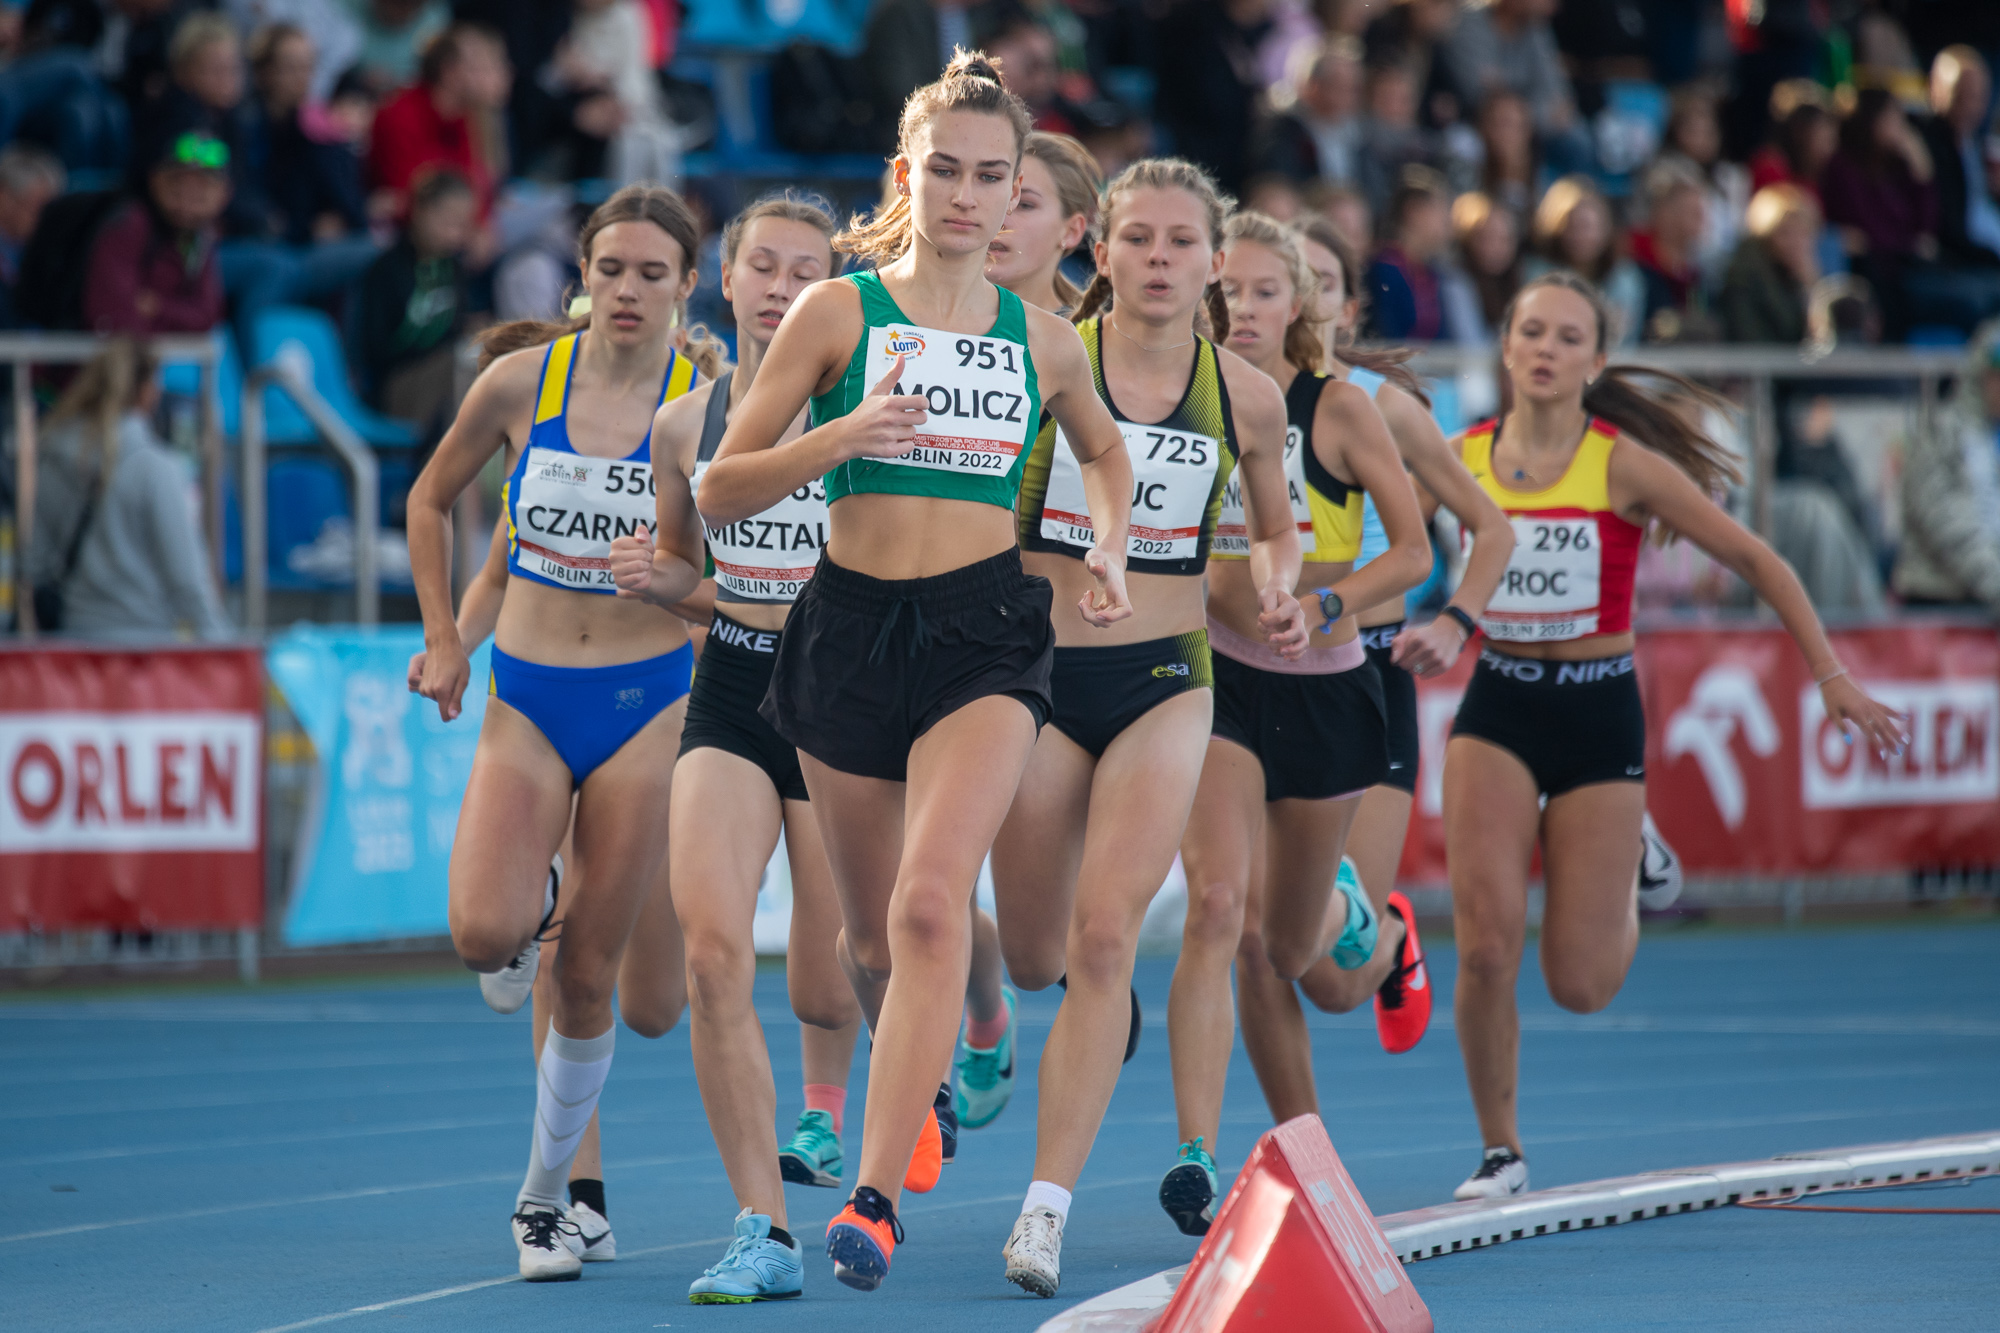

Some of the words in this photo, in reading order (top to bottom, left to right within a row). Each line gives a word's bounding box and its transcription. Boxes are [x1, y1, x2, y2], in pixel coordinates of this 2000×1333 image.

[892, 341, 918, 352] LOTTO
[955, 339, 1018, 374] 951
[875, 382, 1023, 423] MOLICZ
[958, 452, 1002, 470] 2022
[1145, 431, 1208, 467] 725
[1131, 538, 1173, 554] 2022
[1533, 526, 1591, 551] 296
[541, 558, 592, 583] LUBLIN
[1500, 570, 1569, 596] ROC
[724, 575, 770, 594] LUBLIN
[711, 617, 778, 653] NIKE
[1361, 625, 1399, 649] KE
[1481, 650, 1545, 682] PRO
[1555, 654, 1634, 685] NIKE
[10, 741, 237, 823] ORLEN
